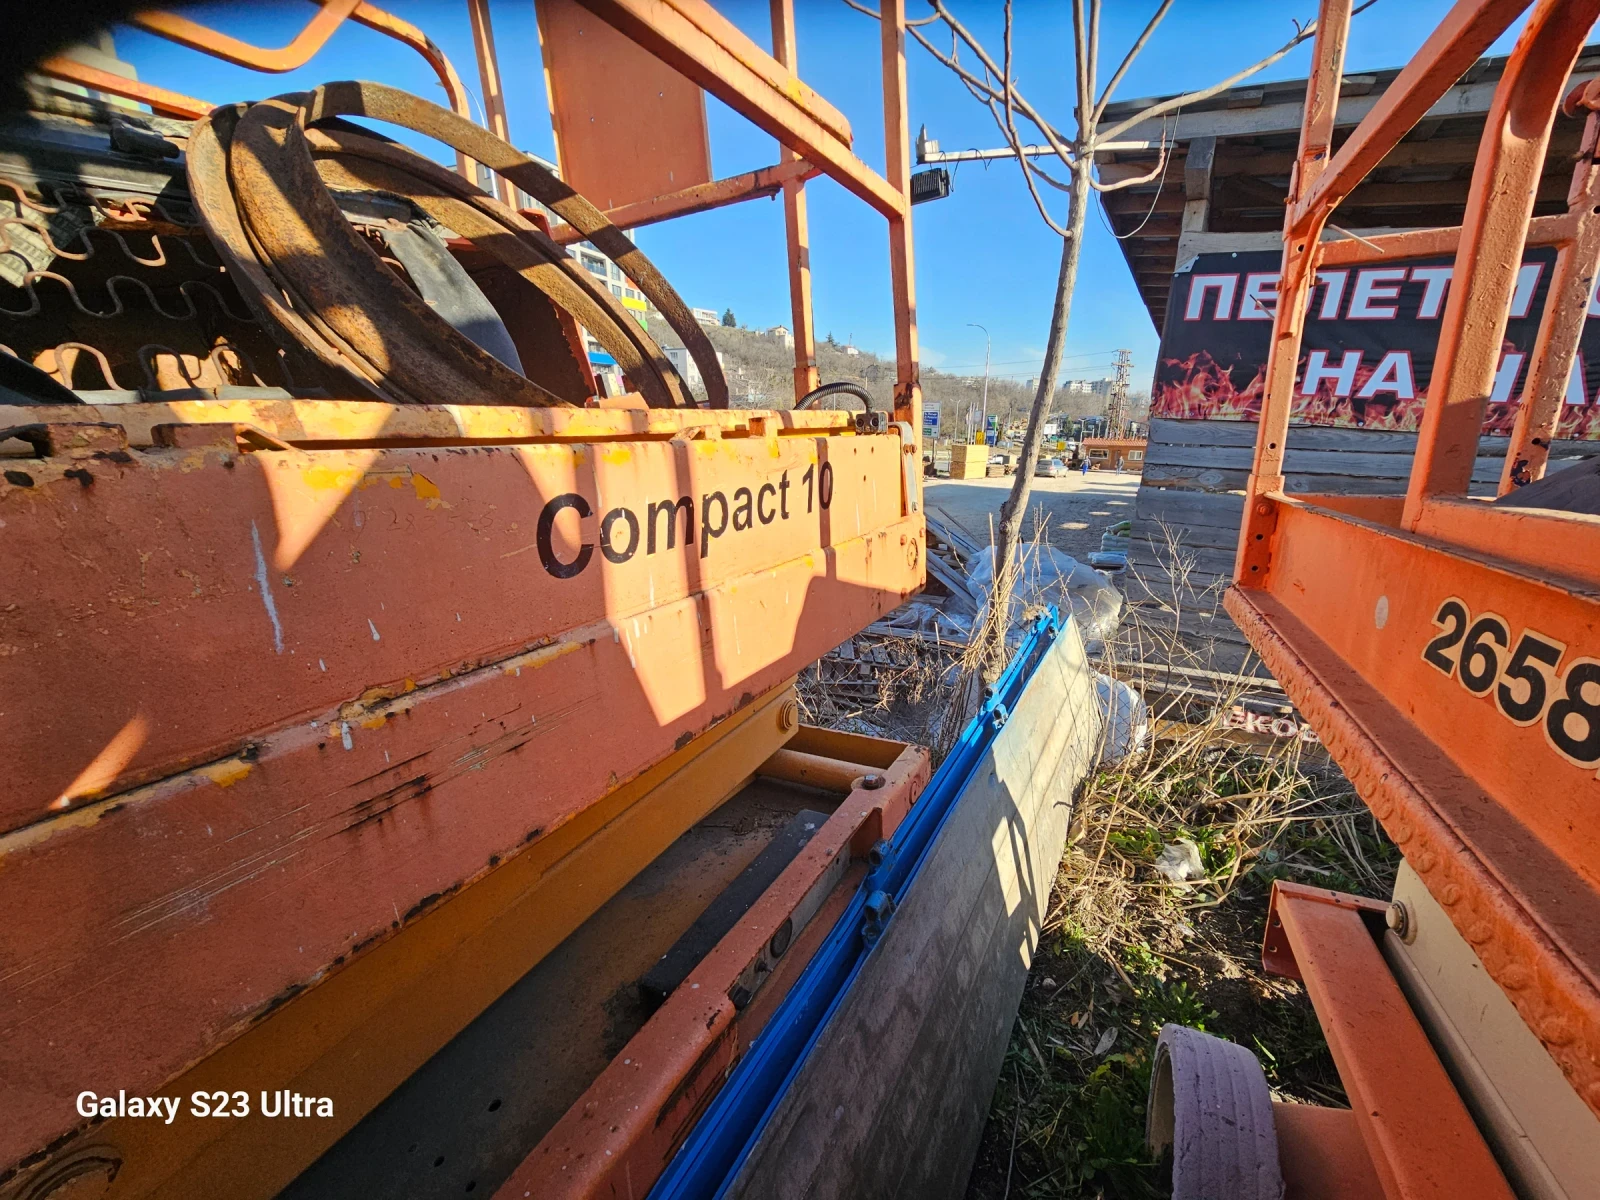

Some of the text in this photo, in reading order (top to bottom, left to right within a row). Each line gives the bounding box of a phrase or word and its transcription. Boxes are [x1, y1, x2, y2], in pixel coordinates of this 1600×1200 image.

[1301, 349, 1417, 399] НА
[536, 460, 834, 579] Compact 10
[1421, 595, 1600, 769] 2658
